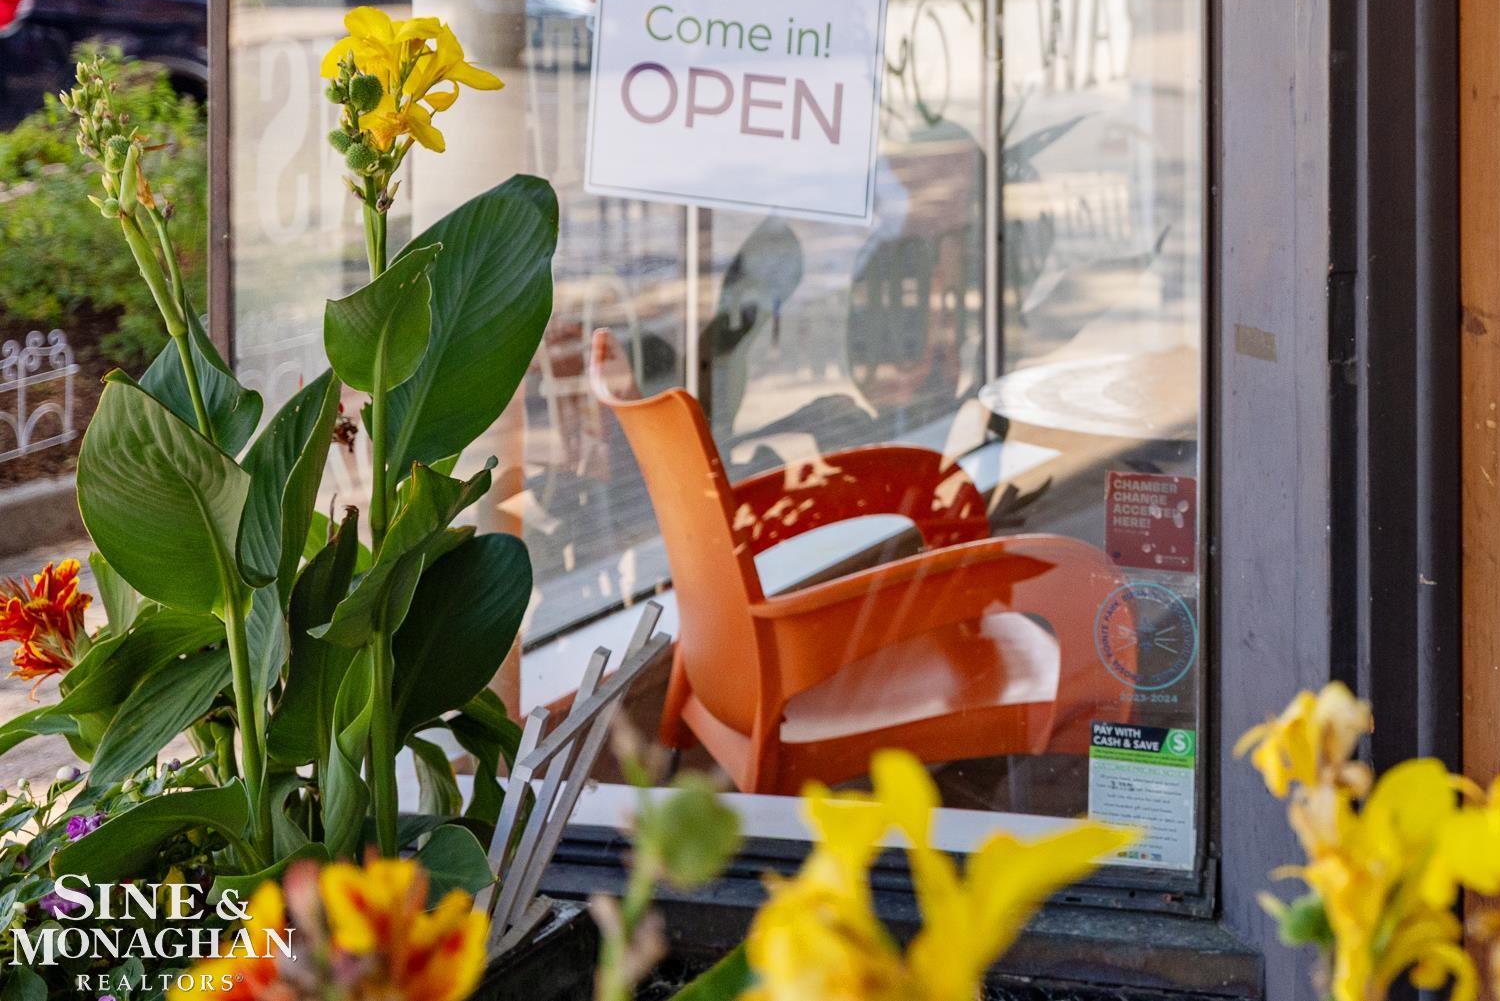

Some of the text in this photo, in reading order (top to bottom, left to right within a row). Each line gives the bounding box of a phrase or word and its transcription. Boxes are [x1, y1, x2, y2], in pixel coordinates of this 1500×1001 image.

[646, 4, 833, 59] Come in!
[621, 61, 844, 145] OPEN
[1093, 724, 1141, 739] PAY WITH
[1093, 735, 1160, 752] CASH & SAVE
